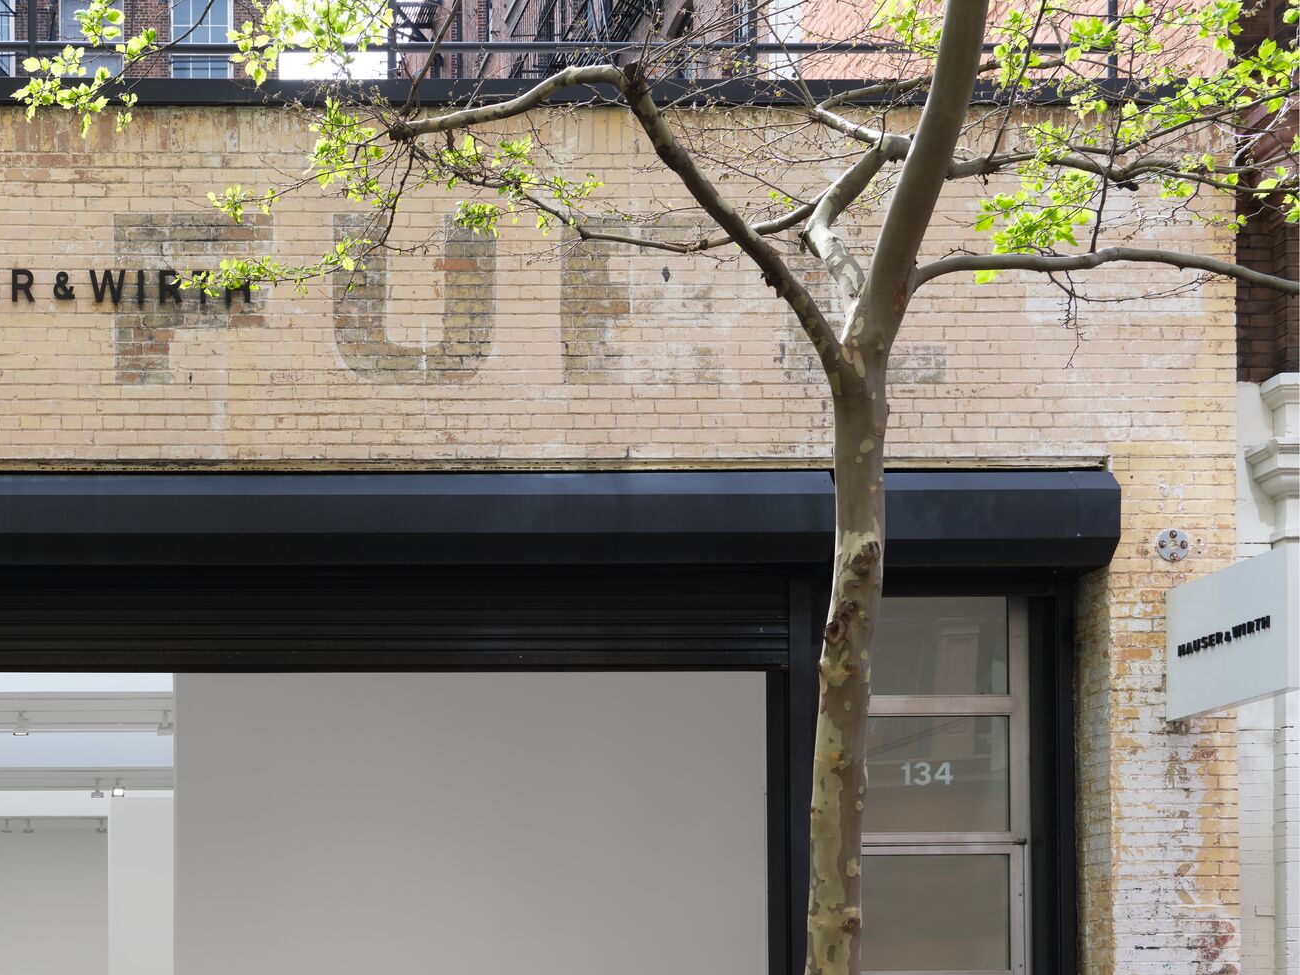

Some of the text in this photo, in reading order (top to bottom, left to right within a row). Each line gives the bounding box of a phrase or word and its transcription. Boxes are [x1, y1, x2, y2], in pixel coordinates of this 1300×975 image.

[53, 269, 75, 301] &
[89, 268, 252, 304] WIRTH
[1177, 630, 1223, 657] HAUSER
[1231, 615, 1271, 639] WIRTH
[901, 761, 954, 786] 134
